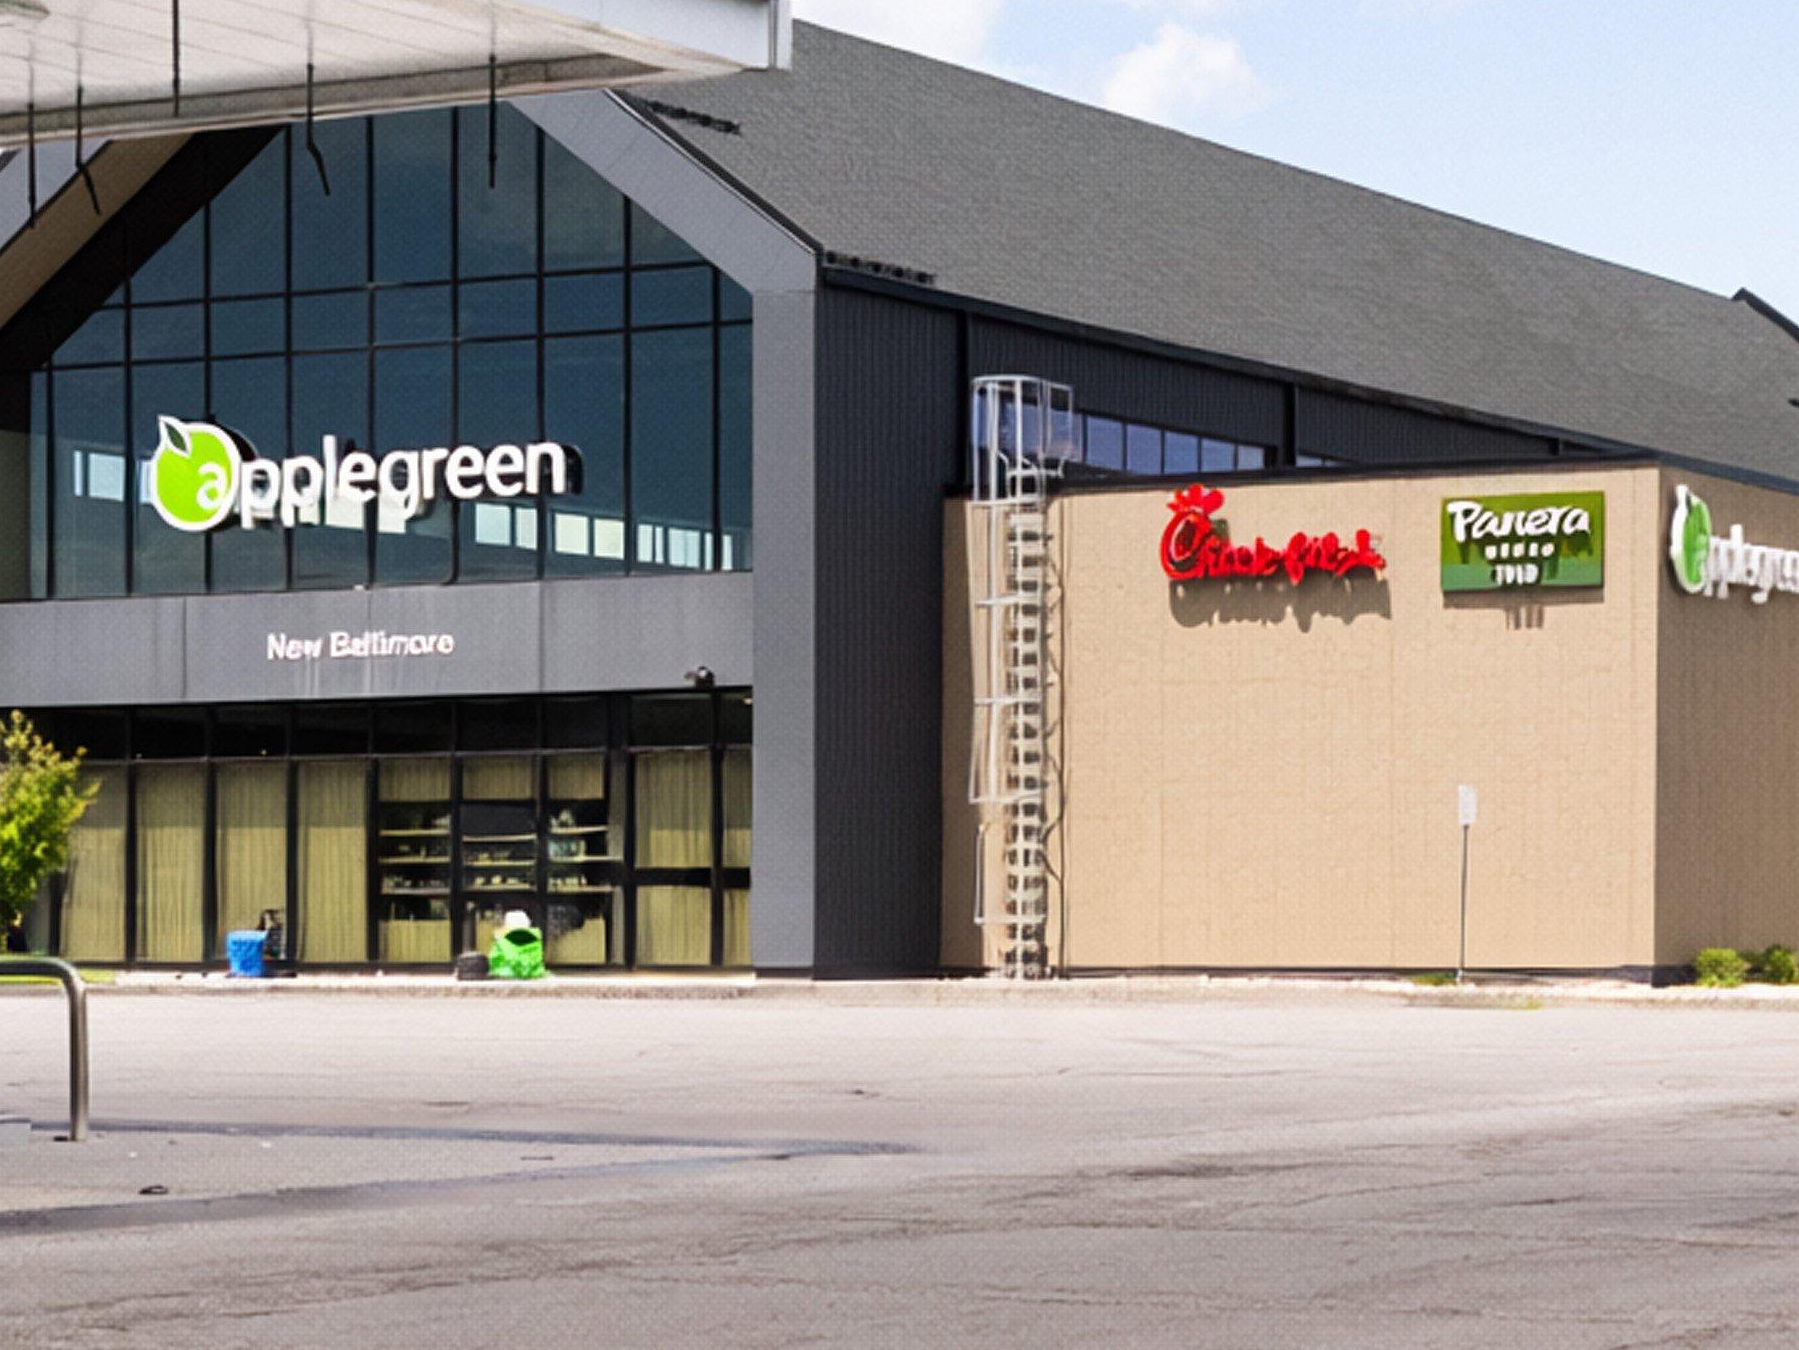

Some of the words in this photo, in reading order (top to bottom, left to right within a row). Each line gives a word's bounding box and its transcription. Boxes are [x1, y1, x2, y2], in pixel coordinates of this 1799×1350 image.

[194, 433, 566, 531] applegreen
[1447, 501, 1591, 543] Panera
[267, 633, 322, 660] New
[329, 630, 455, 658] Baltimore
